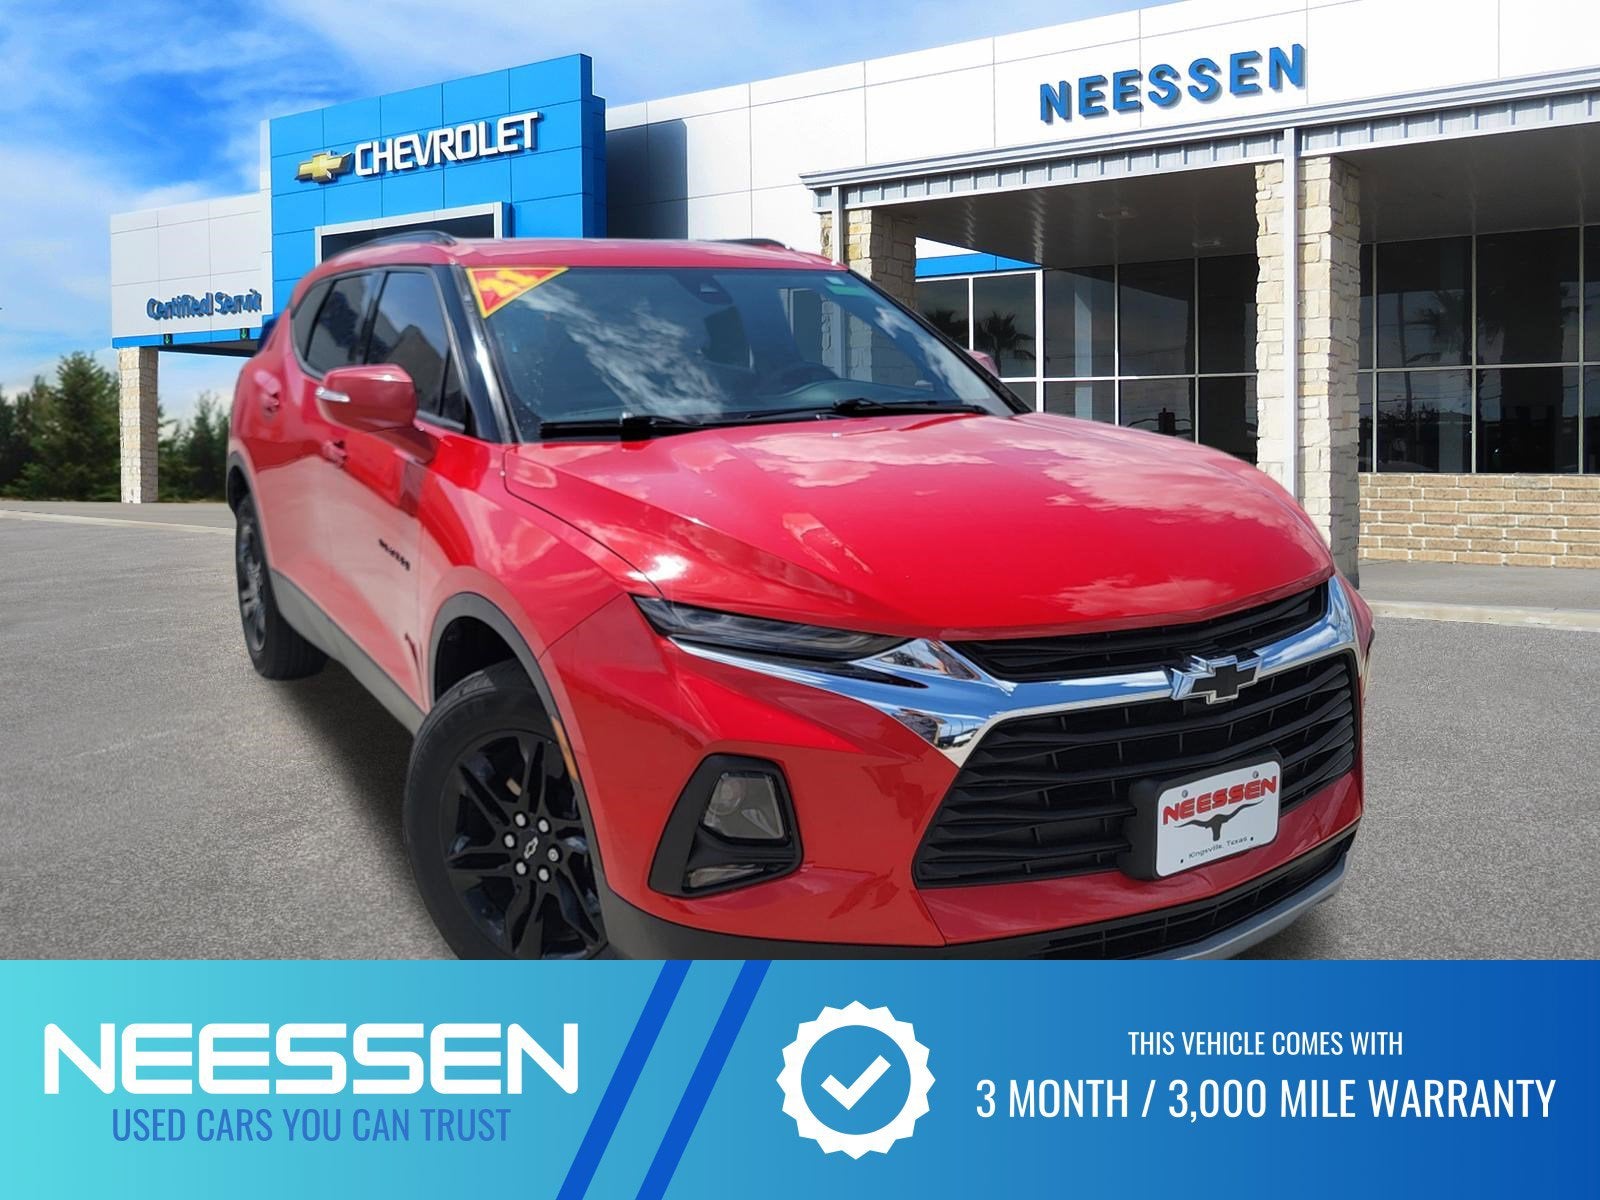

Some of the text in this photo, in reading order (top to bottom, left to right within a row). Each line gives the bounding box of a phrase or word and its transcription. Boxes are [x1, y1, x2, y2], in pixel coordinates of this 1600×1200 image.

[1039, 43, 1306, 124] NEESSEN
[355, 111, 544, 177] CHEVROLET
[146, 292, 213, 320] Certified
[1163, 776, 1277, 825] NEESSEN
